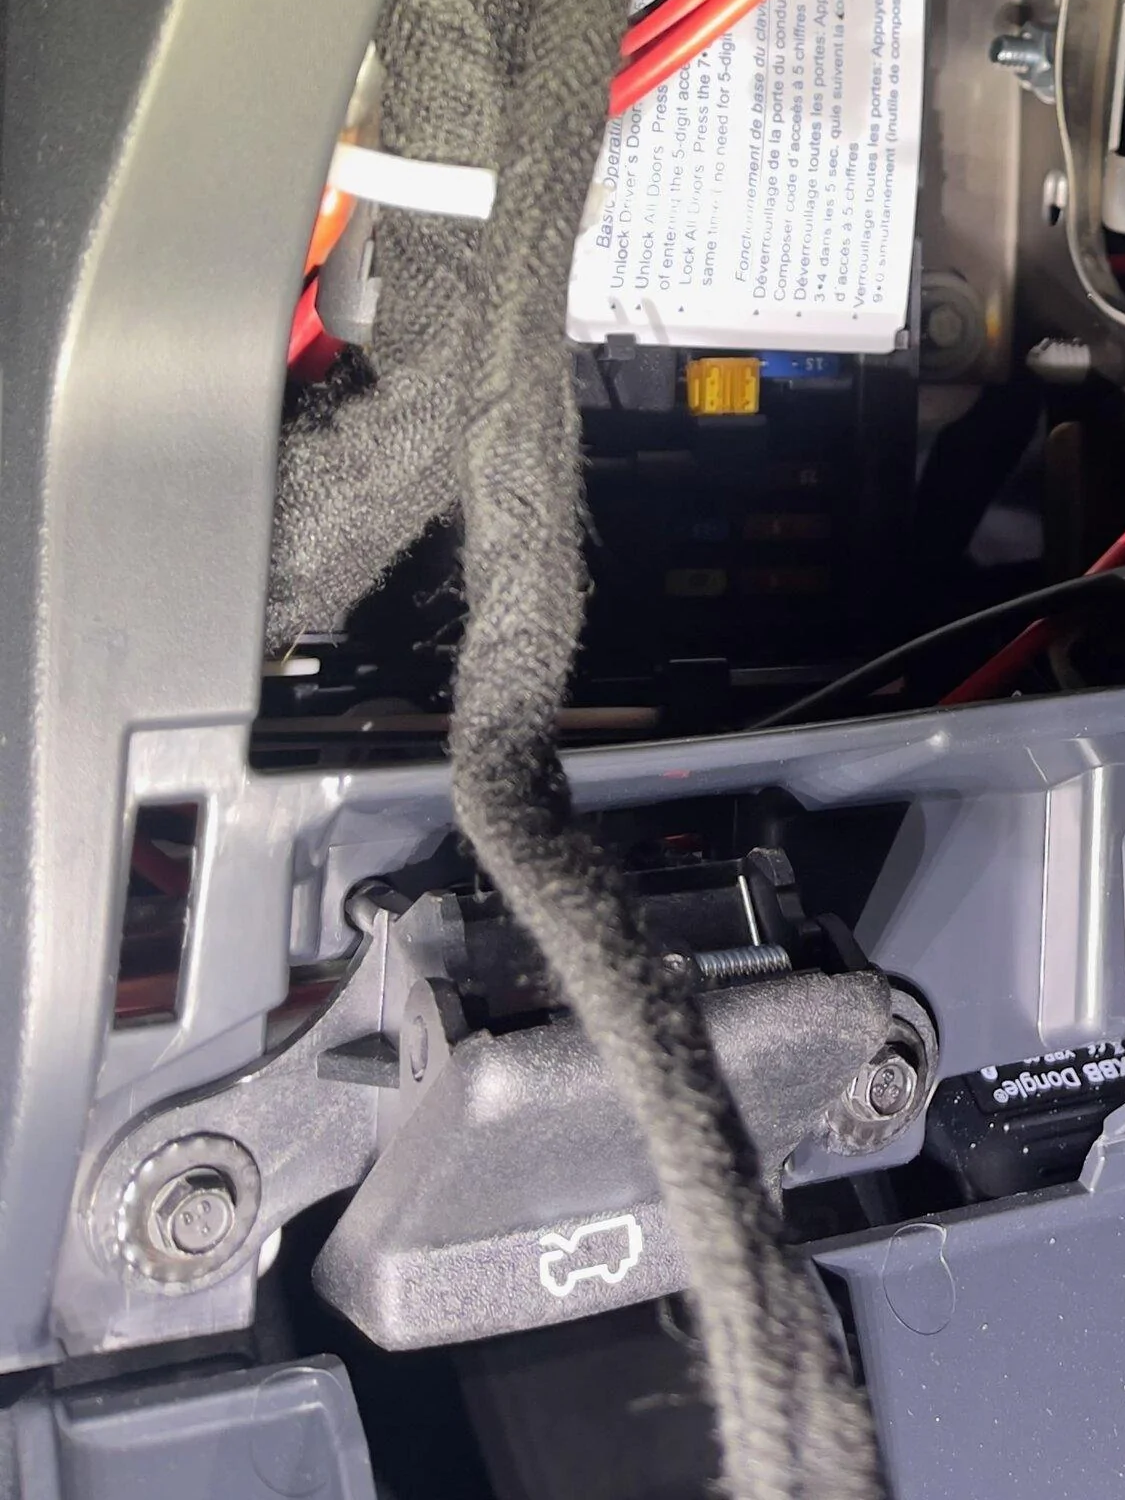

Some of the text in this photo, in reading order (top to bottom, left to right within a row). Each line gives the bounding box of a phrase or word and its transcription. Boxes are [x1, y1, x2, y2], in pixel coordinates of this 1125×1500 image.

[793, 4, 806, 61] chiffres
[834, 24, 844, 38] la
[754, 46, 766, 68] du
[772, 55, 785, 75] du
[793, 66, 804, 75] 5
[814, 32, 827, 87] portes:
[832, 42, 844, 99] suivent
[889, 64, 900, 84] de
[678, 62, 690, 100] acce
[698, 74, 710, 99] the
[716, 86, 730, 108] for
[751, 72, 764, 113] base
[793, 80, 803, 90] à
[870, 63, 882, 118] portes:
[652, 84, 668, 132] Press
[772, 80, 784, 124] porte
[810, 93, 823, 116] les
[886, 89, 898, 142] (inutile
[672, 107, 690, 159] 5-digit
[694, 106, 709, 152] Press
[716, 115, 728, 156] need
[750, 119, 760, 140] de
[769, 129, 781, 143] la
[808, 122, 822, 172] toutes
[867, 123, 880, 146] les
[670, 166, 684, 191] the
[768, 150, 780, 170] de
[844, 142, 859, 200] chiffres
[864, 152, 878, 202] toutes
[596, 118, 620, 248] Basic Operatin
[785, 174, 798, 212] code
[825, 184, 836, 192] 5
[644, 204, 656, 223] All
[822, 198, 834, 221] les
[842, 207, 853, 216] 5
[842, 222, 852, 232] à
[685, 220, 697, 240] All
[752, 176, 779, 298] Déverrouillage
[793, 178, 819, 300] Déverrouillage
[819, 228, 832, 266] dans
[610, 230, 630, 288] Unlock
[635, 231, 654, 289] Unlock
[679, 247, 695, 285] Lock
[701, 241, 717, 286] same
[774, 220, 792, 301] Composer
[852, 209, 874, 308] Verrouillage
[658, 274, 670, 290] of
